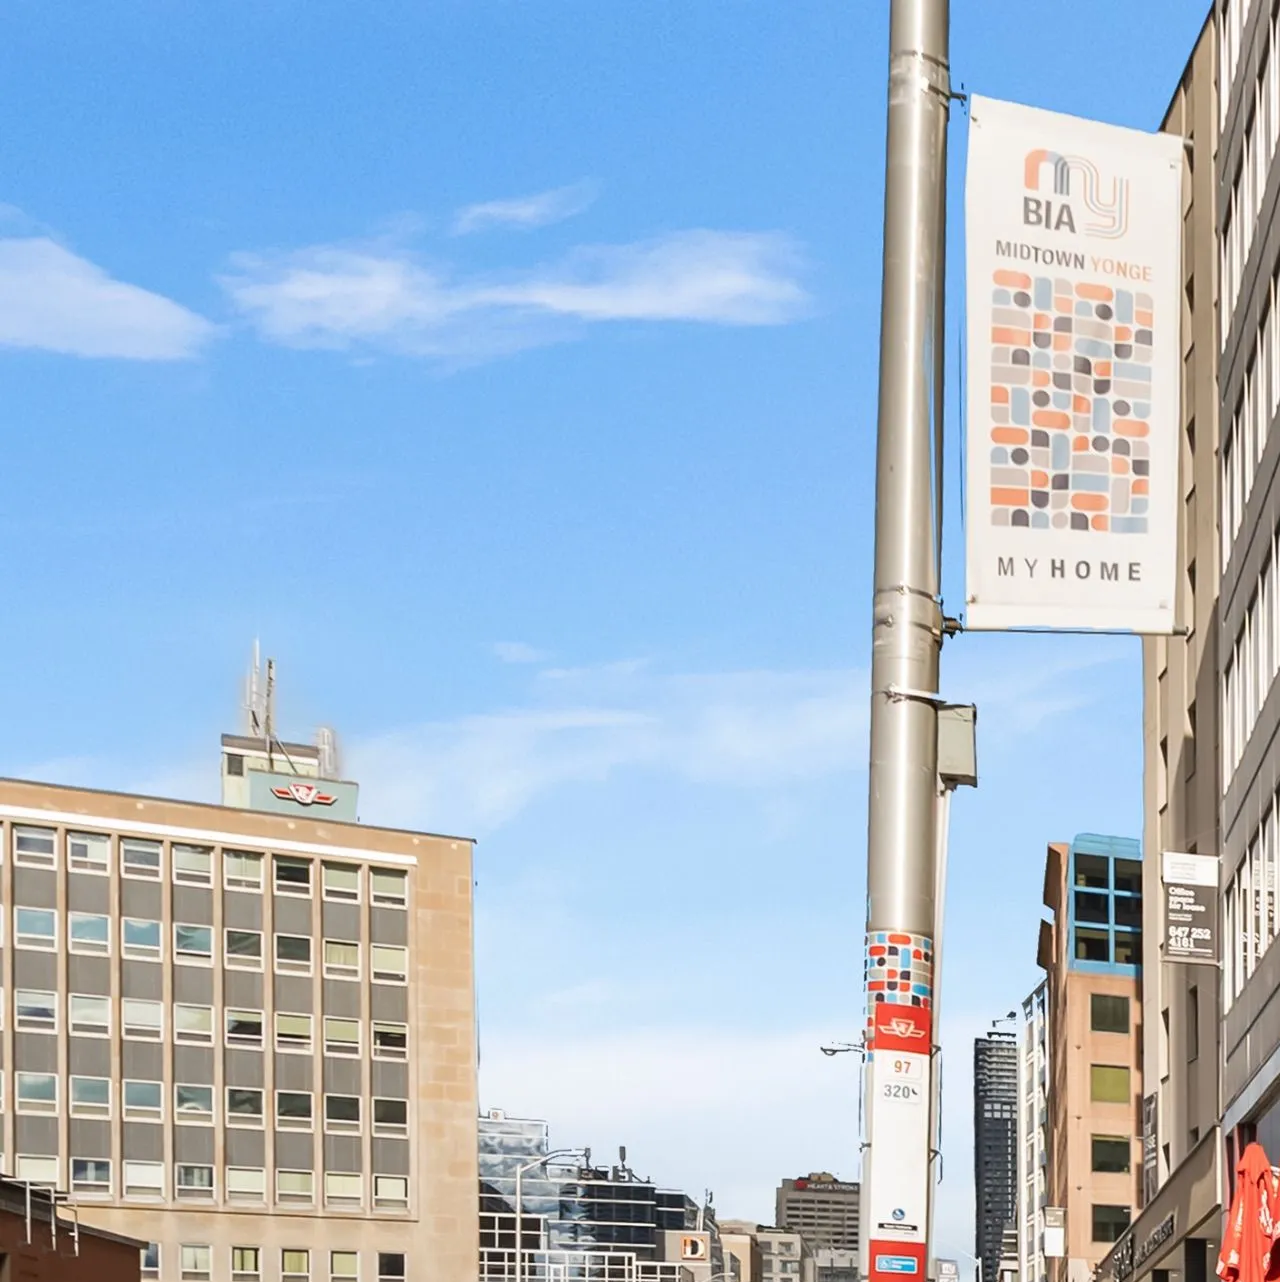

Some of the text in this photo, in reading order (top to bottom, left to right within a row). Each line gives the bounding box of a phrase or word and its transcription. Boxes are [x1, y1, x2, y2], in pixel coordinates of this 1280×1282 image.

[1024, 196, 1076, 233] BIA
[996, 240, 1152, 282] MIDTOWN YONGE
[895, 1060, 911, 1074] 97
[884, 1084, 910, 1099] 320
